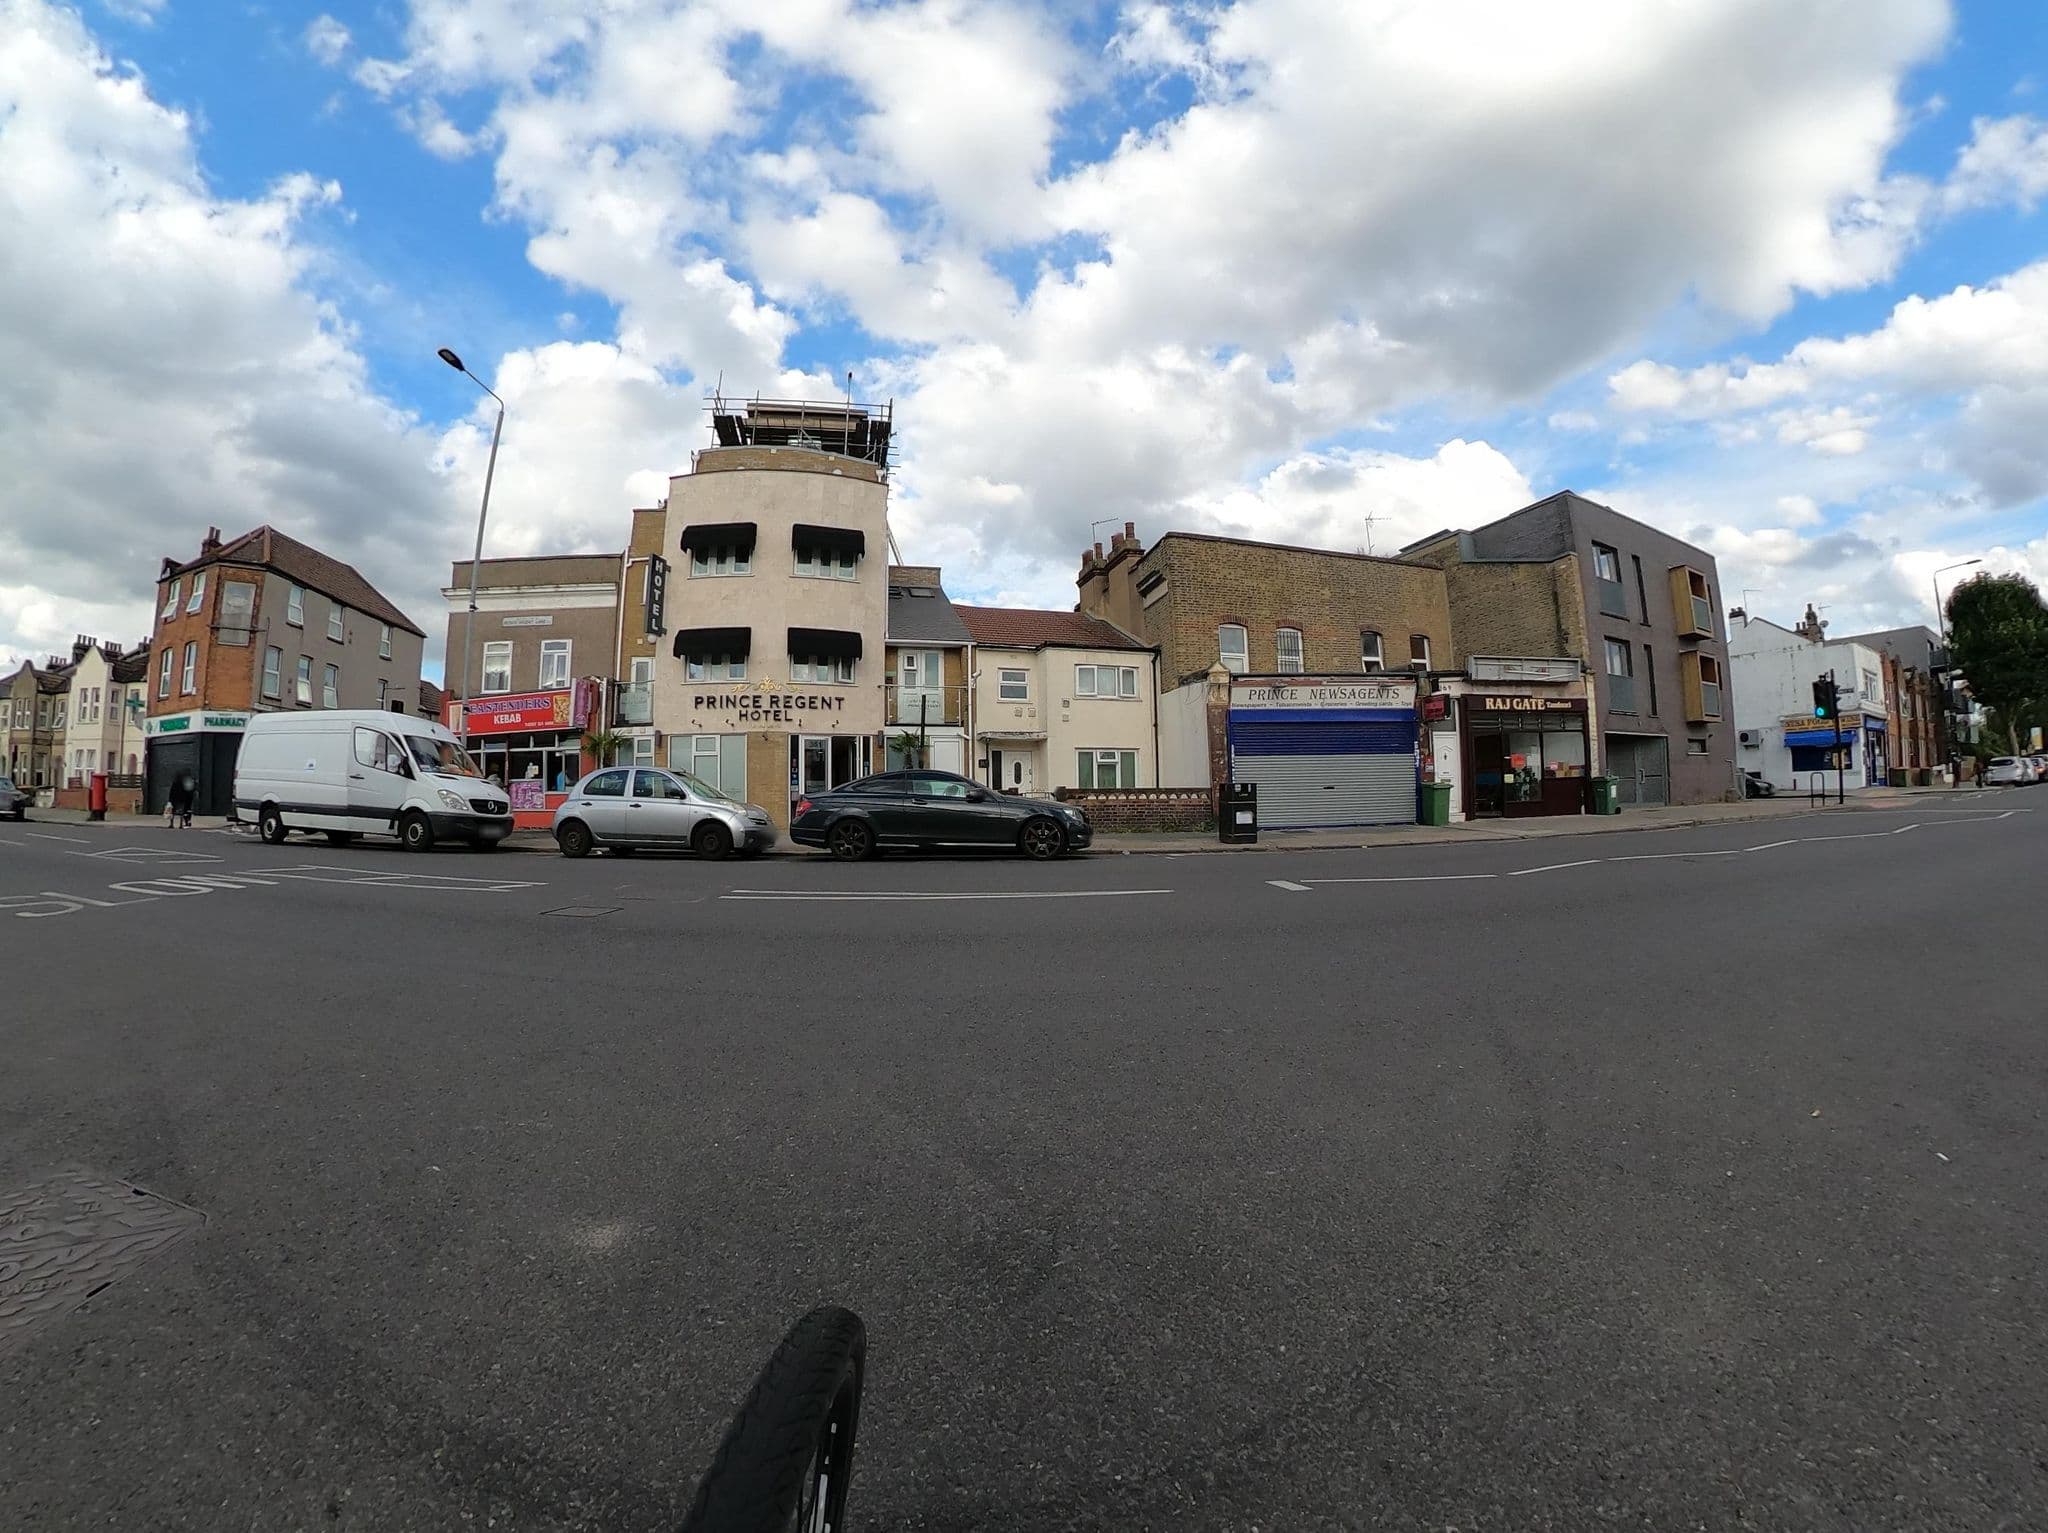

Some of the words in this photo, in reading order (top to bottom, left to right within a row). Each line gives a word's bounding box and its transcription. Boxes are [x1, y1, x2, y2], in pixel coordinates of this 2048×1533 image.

[651, 560, 664, 631] HOTEL
[1248, 688, 1298, 700] PRINCE
[1309, 687, 1400, 700] NEWSAGENTS
[468, 696, 551, 714] EASTENDERS
[694, 694, 763, 710] PRINCE
[769, 694, 845, 710] REGENT
[1485, 697, 1511, 710] RAJ
[1512, 698, 1546, 711] GATE
[203, 716, 248, 727] PHARMACY
[493, 713, 522, 725] KEBAB
[738, 709, 794, 722] HOTEL
